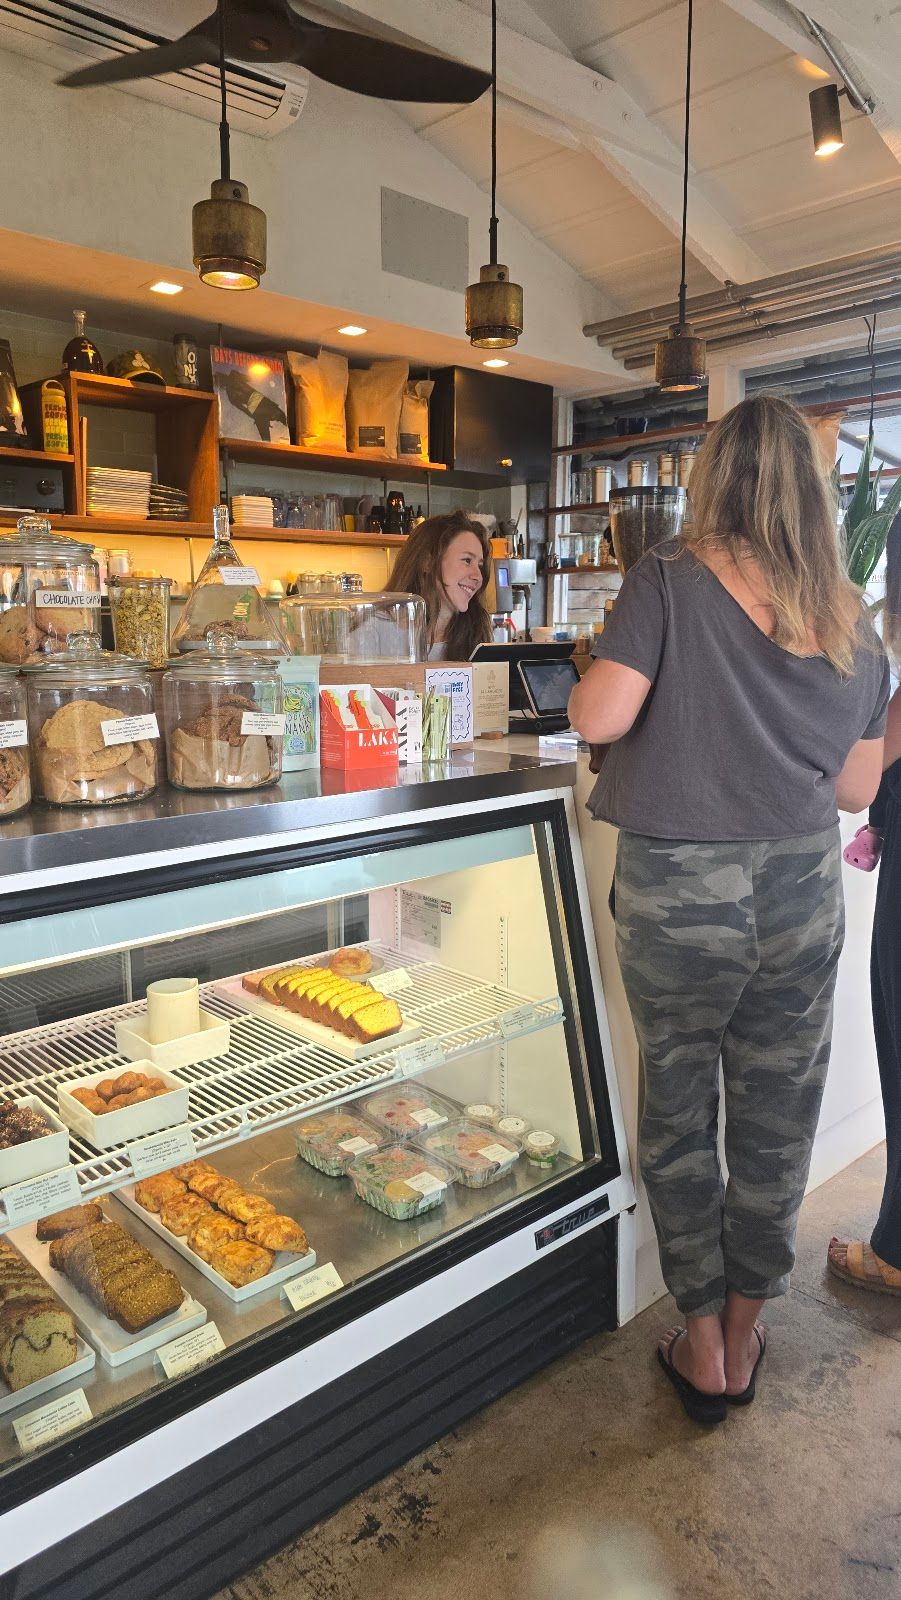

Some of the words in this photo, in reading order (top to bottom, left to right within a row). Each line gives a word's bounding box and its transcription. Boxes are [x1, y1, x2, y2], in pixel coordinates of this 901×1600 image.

[213, 347, 233, 365] DAYS
[43, 593, 85, 606] CHOCOLATE
[358, 731, 398, 747] LAKA
